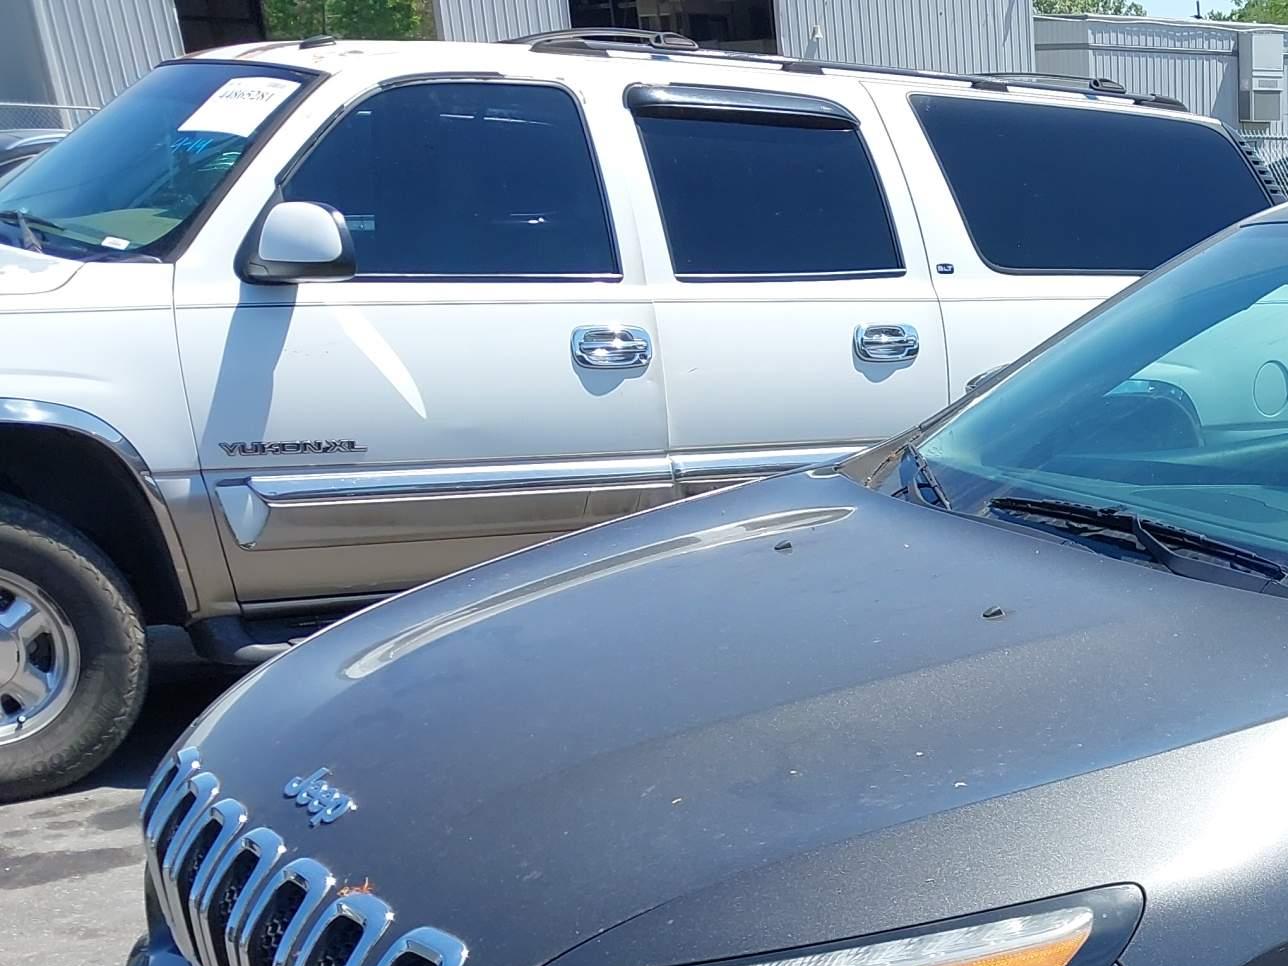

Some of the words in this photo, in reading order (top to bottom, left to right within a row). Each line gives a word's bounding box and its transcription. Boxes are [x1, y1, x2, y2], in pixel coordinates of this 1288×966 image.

[218, 441, 322, 456] YUKON
[324, 439, 368, 454] XL
[284, 767, 357, 826] Jeep
